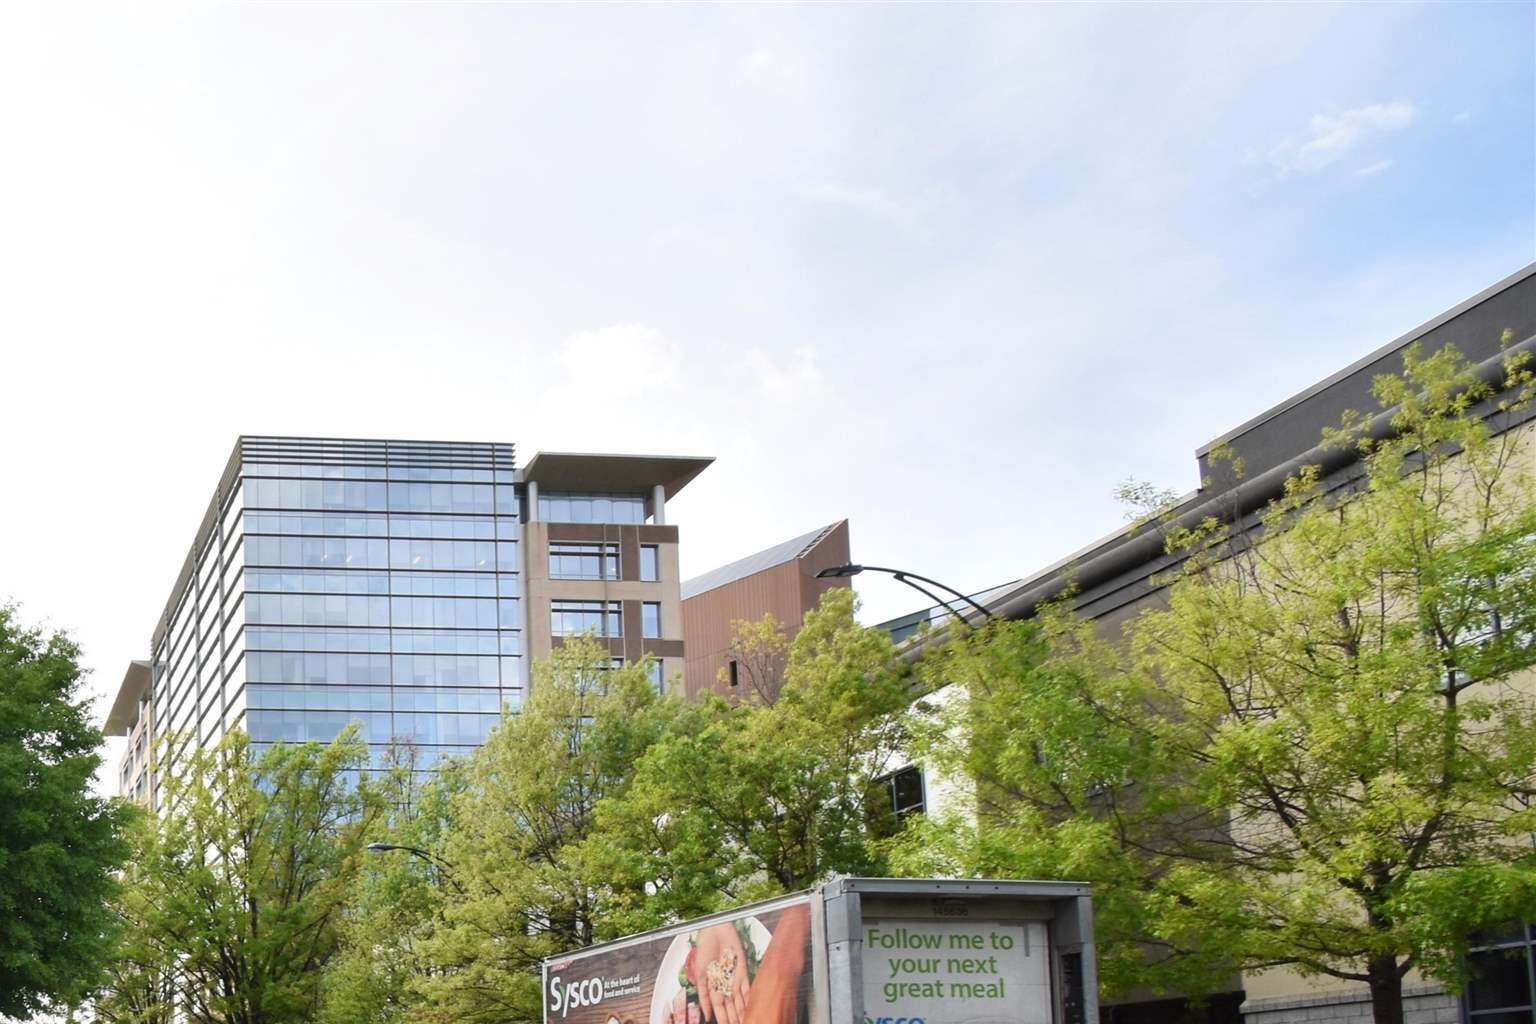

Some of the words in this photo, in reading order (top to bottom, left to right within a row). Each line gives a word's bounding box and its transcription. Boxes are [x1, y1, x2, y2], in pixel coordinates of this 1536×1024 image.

[867, 927, 943, 950] Follow
[949, 933, 984, 950] me
[990, 931, 1014, 950] to
[888, 957, 941, 979] your
[948, 955, 998, 974] next
[604, 989, 615, 999] food
[615, 987, 624, 997] and
[624, 985, 641, 995] service
[611, 978, 619, 988] the
[619, 976, 634, 986] heart
[634, 973, 641, 984] of
[883, 979, 944, 1003] great
[951, 977, 1005, 999] meal
